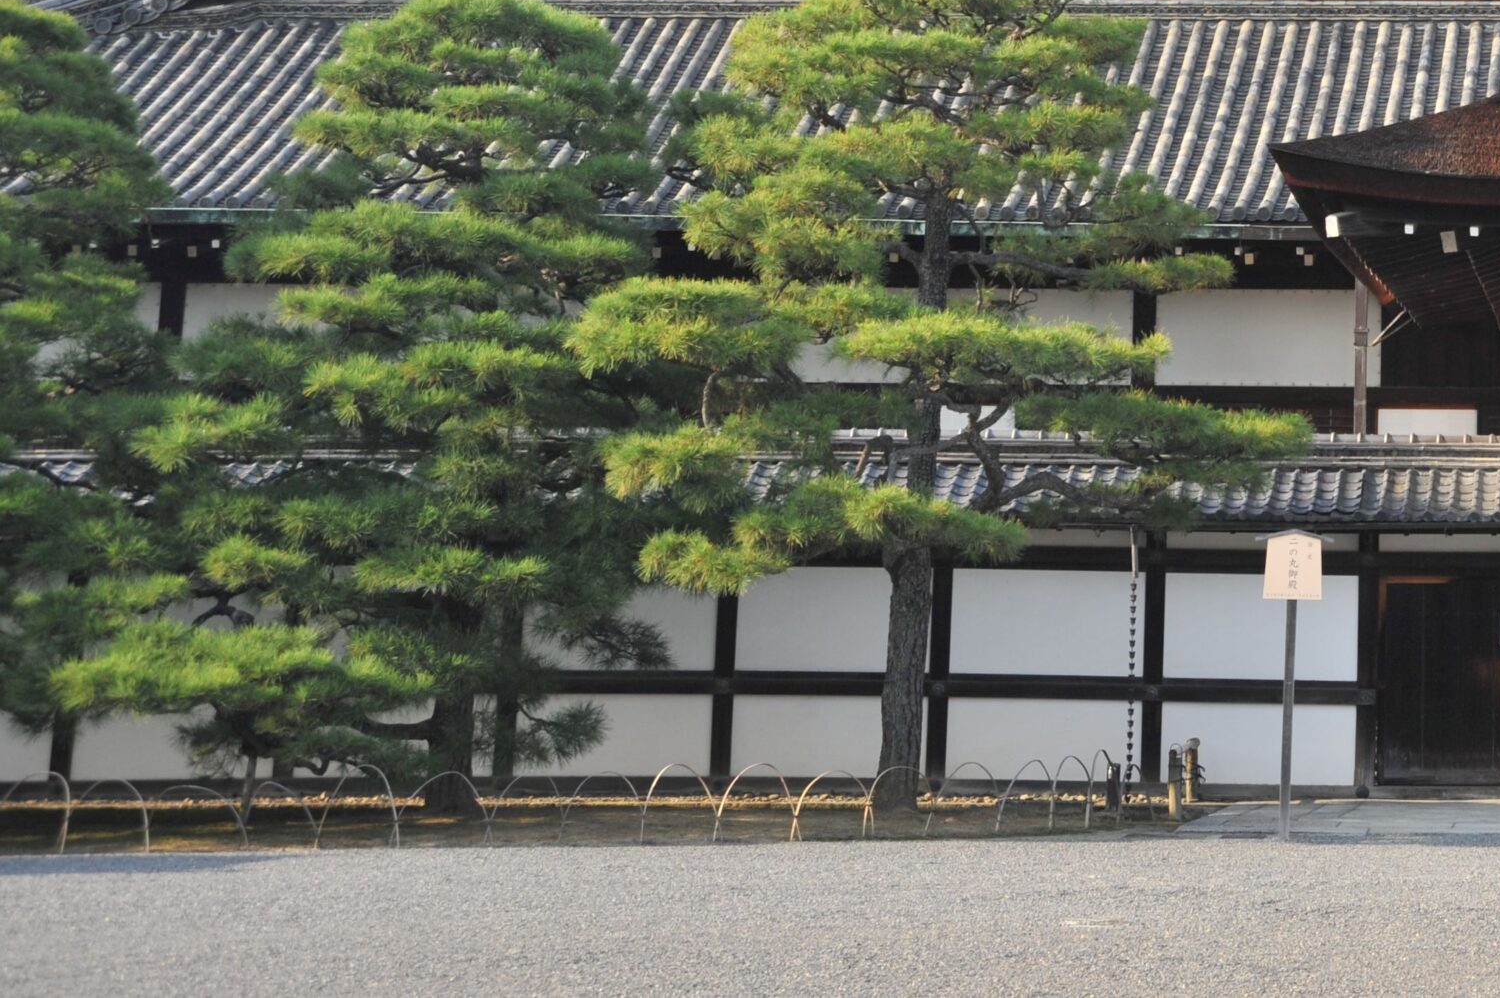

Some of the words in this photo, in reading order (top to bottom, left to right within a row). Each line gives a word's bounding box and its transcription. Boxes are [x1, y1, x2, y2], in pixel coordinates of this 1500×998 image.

[1288, 538, 1299, 590] 二の丸御殿
